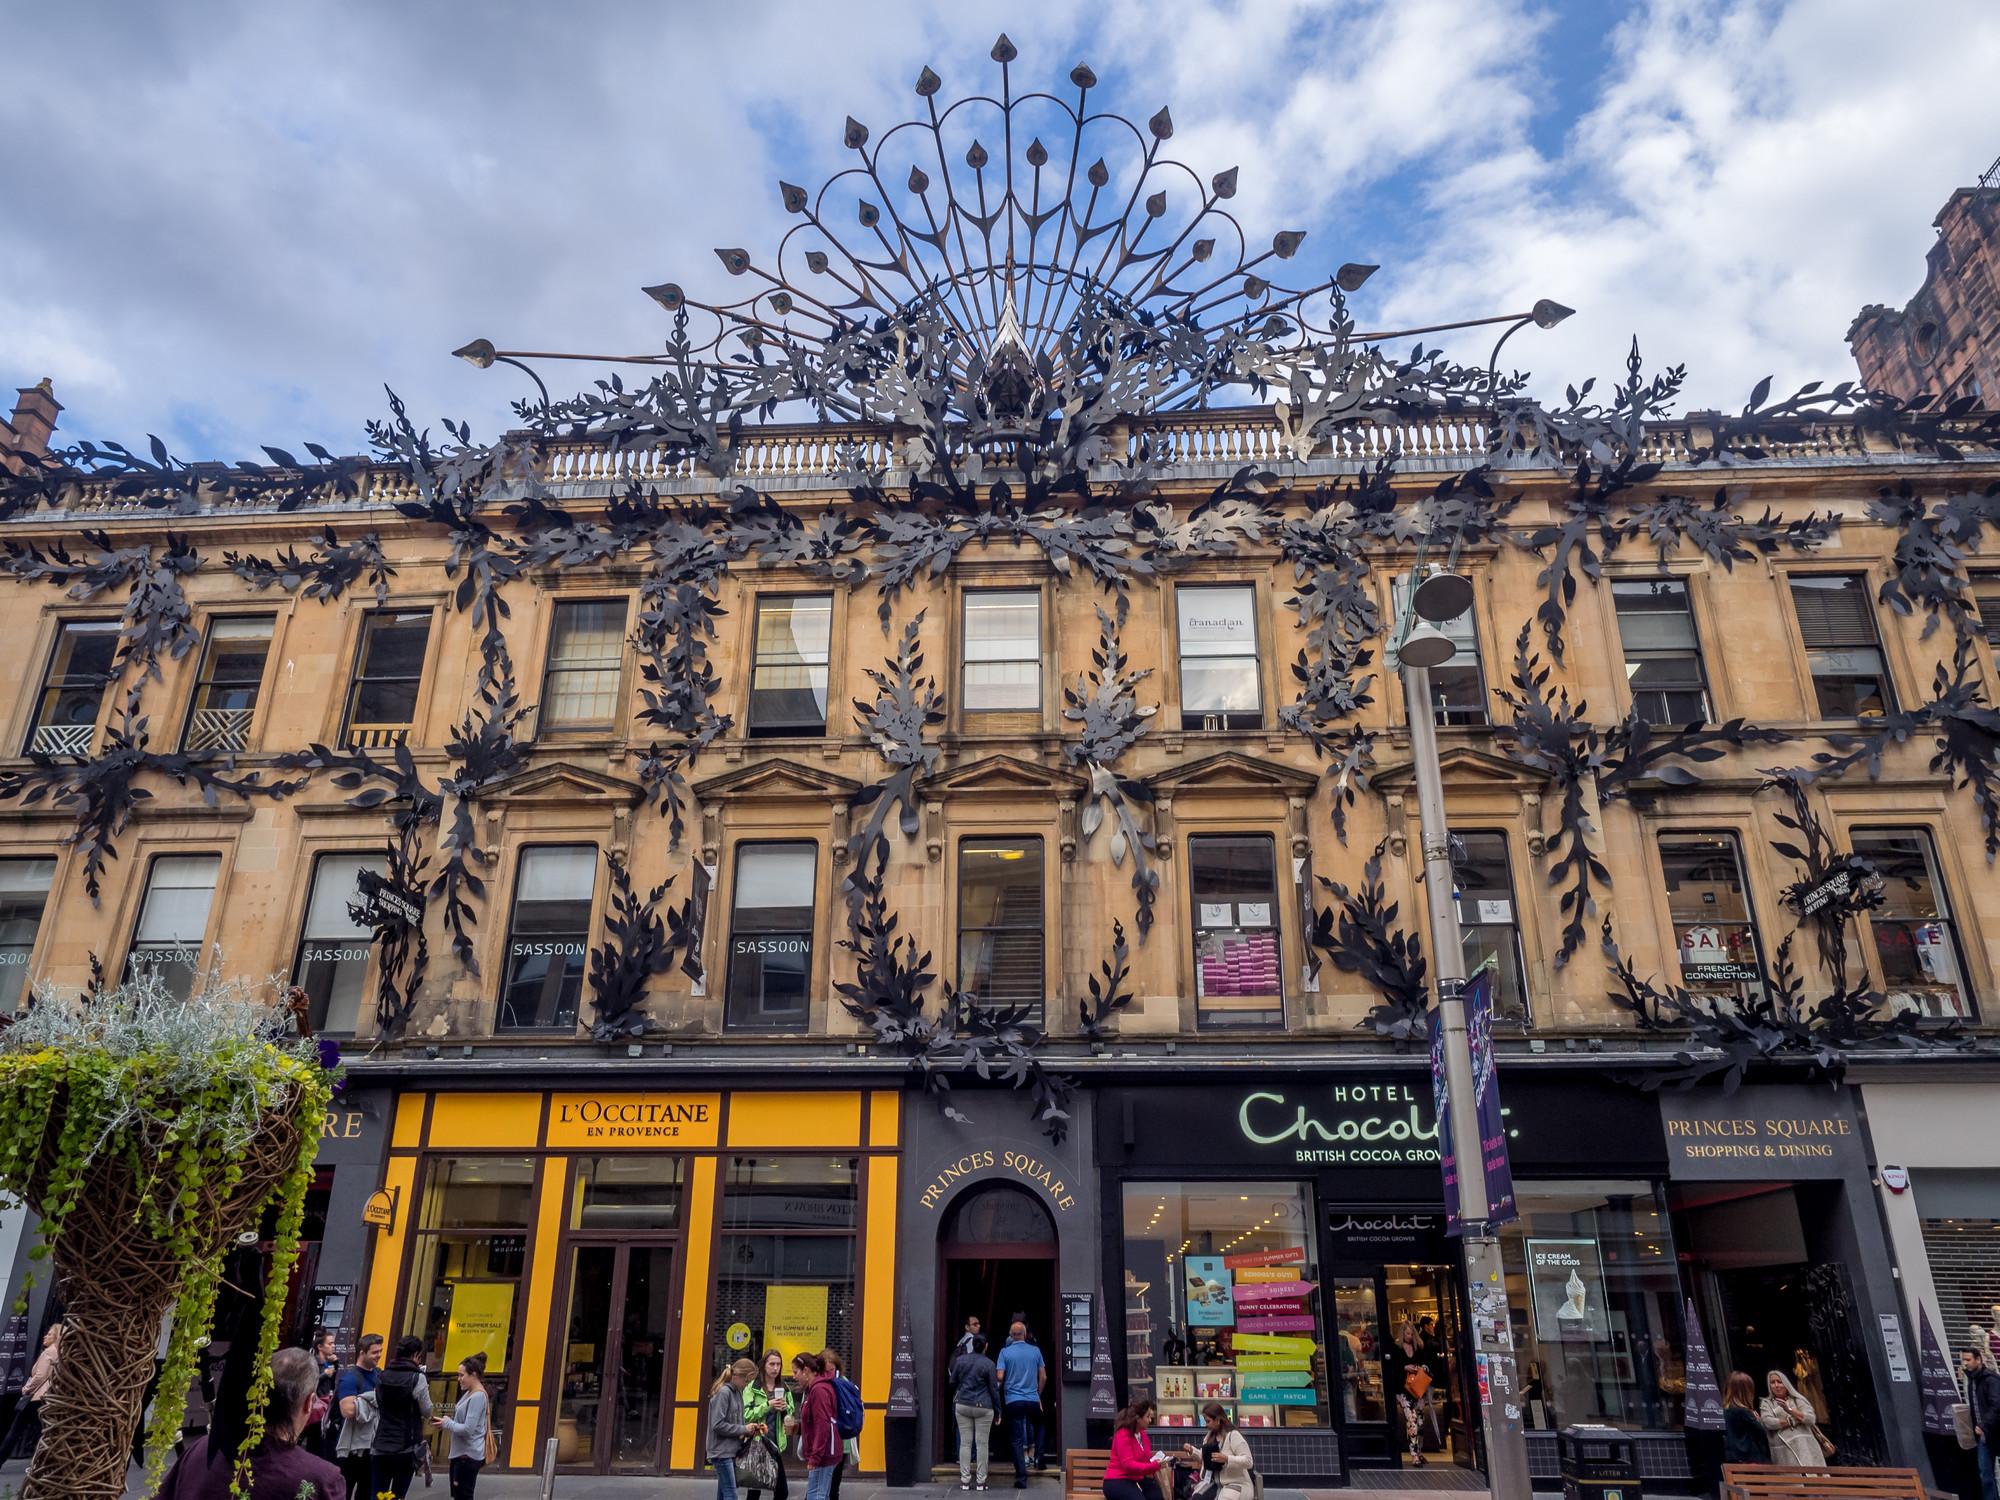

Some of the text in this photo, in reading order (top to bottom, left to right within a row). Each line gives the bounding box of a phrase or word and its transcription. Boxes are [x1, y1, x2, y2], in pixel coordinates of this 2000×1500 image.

[1683, 933, 1744, 948] SALE
[1880, 928, 1942, 945] SALE
[513, 943, 585, 955] SASSOON
[736, 941, 810, 953] SASSOON
[1685, 972, 1756, 980] CONNECTION
[1335, 1087, 1414, 1101] HOTEL
[560, 1100, 709, 1123] L'OCCITANE
[587, 1127, 680, 1137] EN PROVENCE
[1668, 1119, 1851, 1139] PRINCES SQUARE
[1296, 1150, 1345, 1162] BRITISH
[1350, 1150, 1401, 1162] COCOA
[1686, 1144, 1833, 1158] SHOPPING & DINING
[919, 1150, 1075, 1211] PRINCES SQUARE
[316, 1298, 324, 1309] 3
[1065, 1304, 1071, 1314] 3
[314, 1314, 321, 1325] 2
[1065, 1318, 1071, 1328] 2
[1066, 1332, 1070, 1342] 1
[1065, 1346, 1072, 1355] 0
